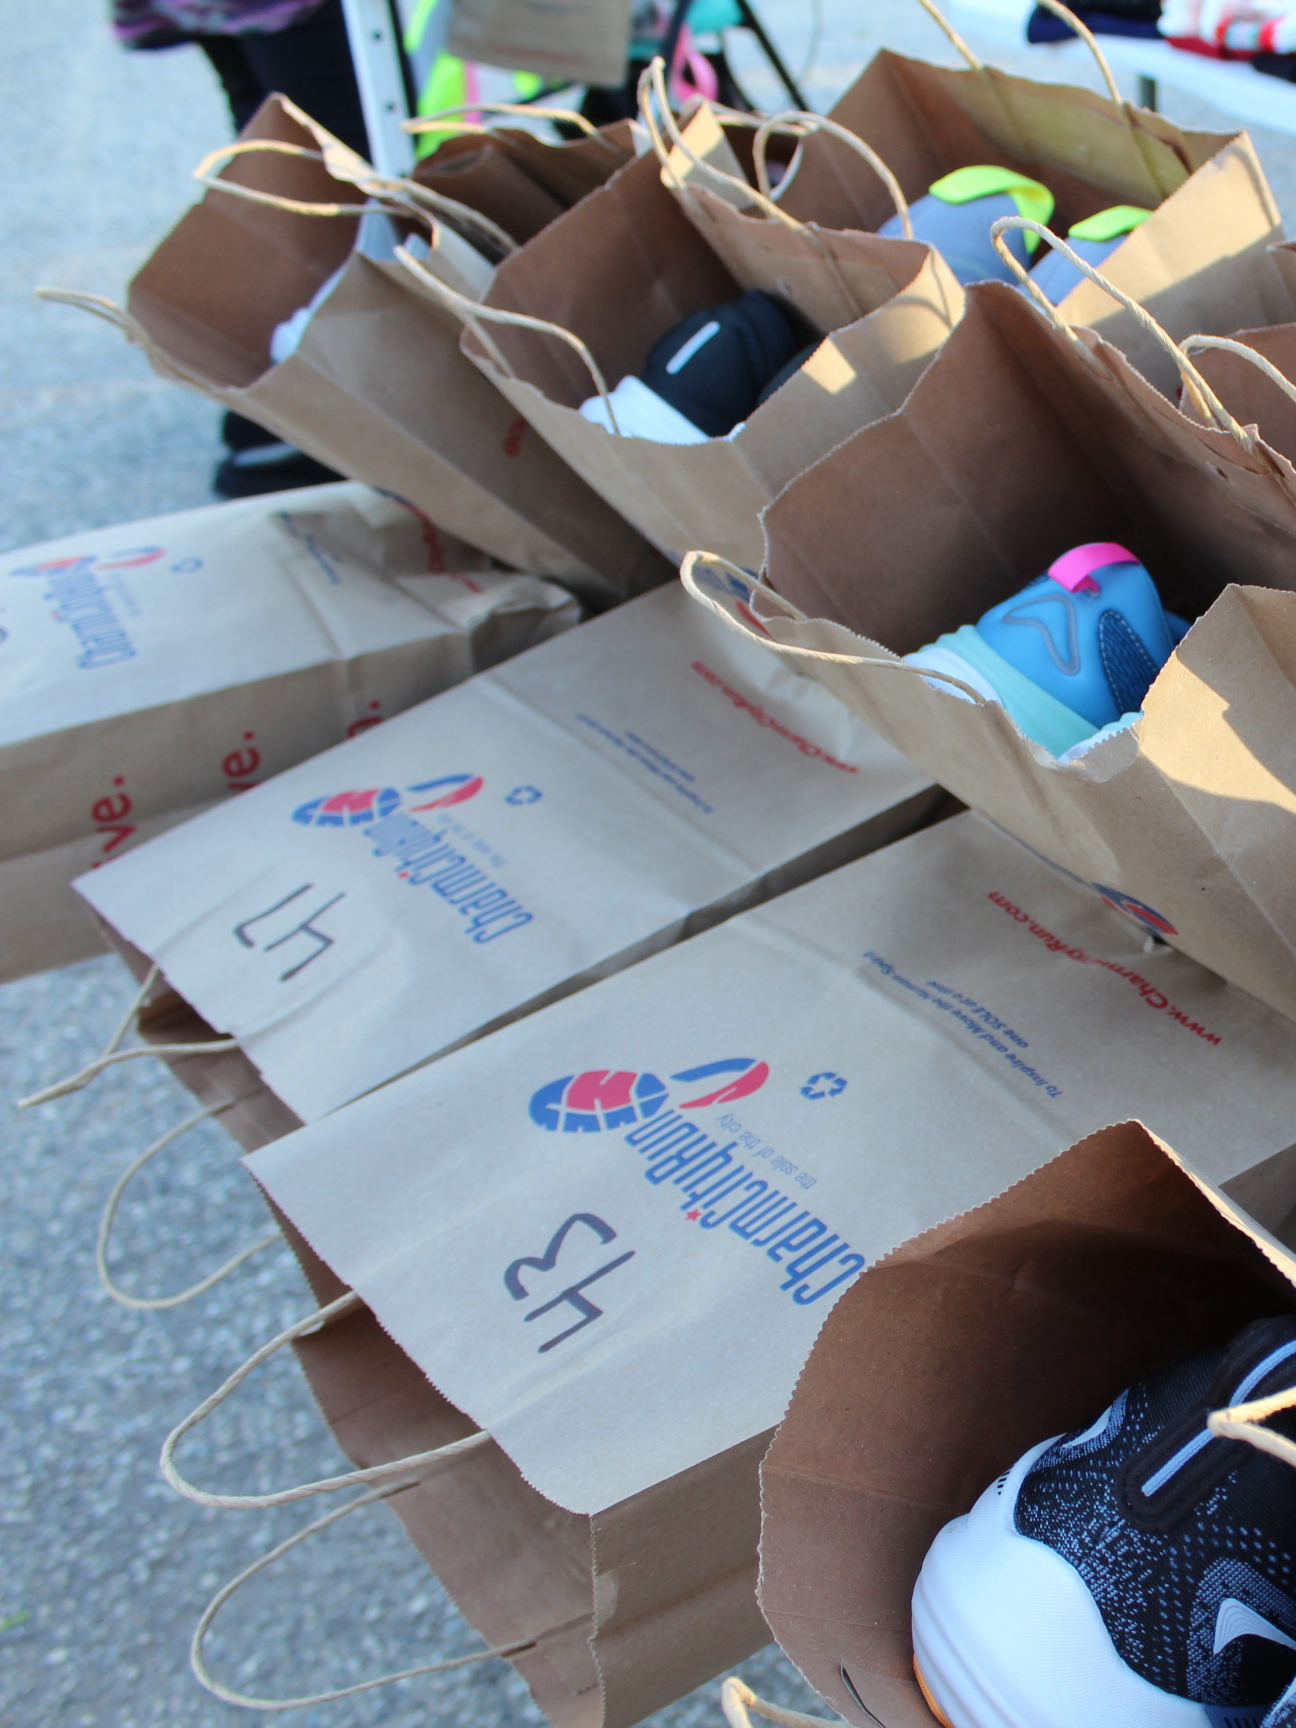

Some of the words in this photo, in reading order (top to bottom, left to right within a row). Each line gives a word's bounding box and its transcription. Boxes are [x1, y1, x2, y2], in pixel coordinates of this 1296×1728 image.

[931, 997, 953, 1011] the
[950, 1009, 985, 1034] Move
[970, 1006, 1006, 1030] SOLE
[978, 1032, 1008, 1053] and
[1003, 1029, 1029, 1049] one
[1004, 1053, 1049, 1086] Inspire
[1045, 1084, 1063, 1098] To
[716, 1112, 742, 1134] city
[738, 1131, 761, 1151] the
[753, 1147, 775, 1159] of
[770, 1155, 798, 1177] sole
[794, 1172, 818, 1190] the
[624, 1109, 866, 1306] CharmCityRun
[503, 1212, 636, 1354] 43
